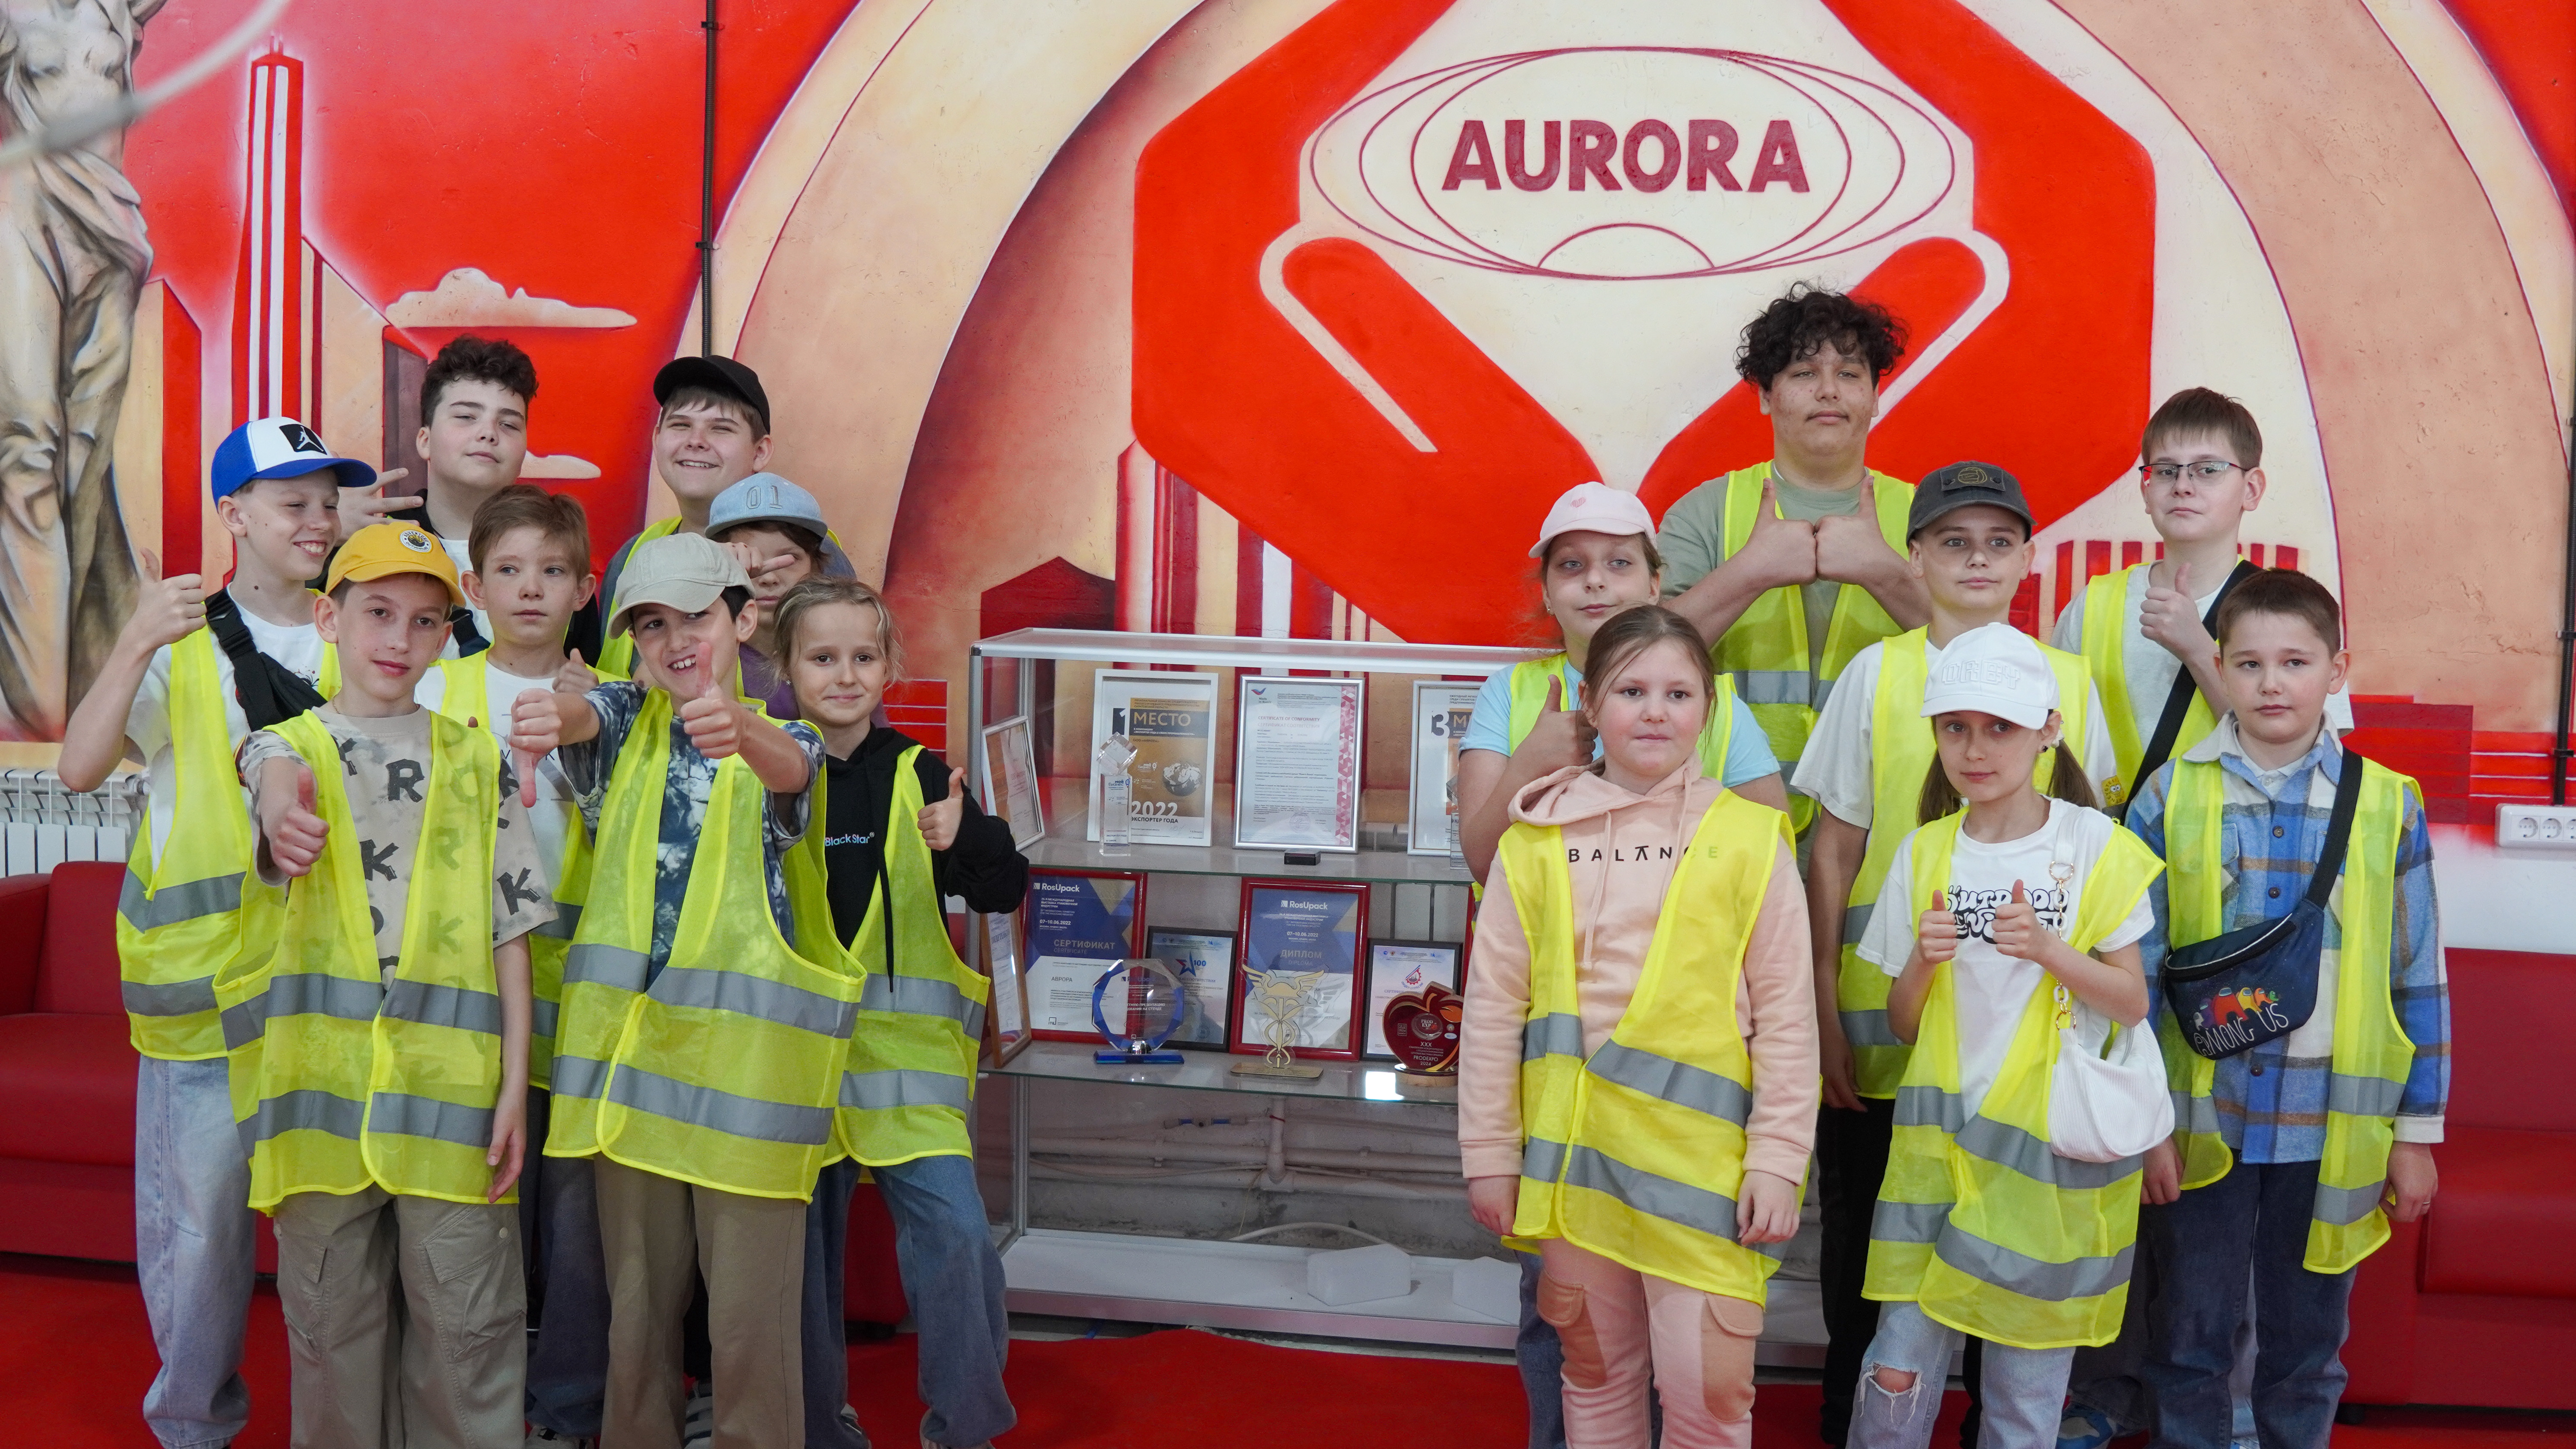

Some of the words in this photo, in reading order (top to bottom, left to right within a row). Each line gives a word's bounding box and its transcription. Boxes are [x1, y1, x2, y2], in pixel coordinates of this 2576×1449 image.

[1442, 118, 1810, 194] AURORA
[746, 485, 783, 509] 01
[1941, 660, 2020, 689] ORBY
[1133, 712, 1191, 727] МЕСТО
[1432, 710, 1450, 738] 3
[1453, 715, 1471, 728] М
[386, 758, 425, 803] R
[1132, 800, 1178, 816] 2022
[497, 867, 541, 915] K
[1042, 883, 1080, 893] RosUpack
[1289, 900, 1328, 911] RosUpack
[1054, 939, 1116, 950] СЕРТИФИКАТ
[1280, 949, 1322, 959] ДИПЛОМ
[2257, 1003, 2288, 1032] US
